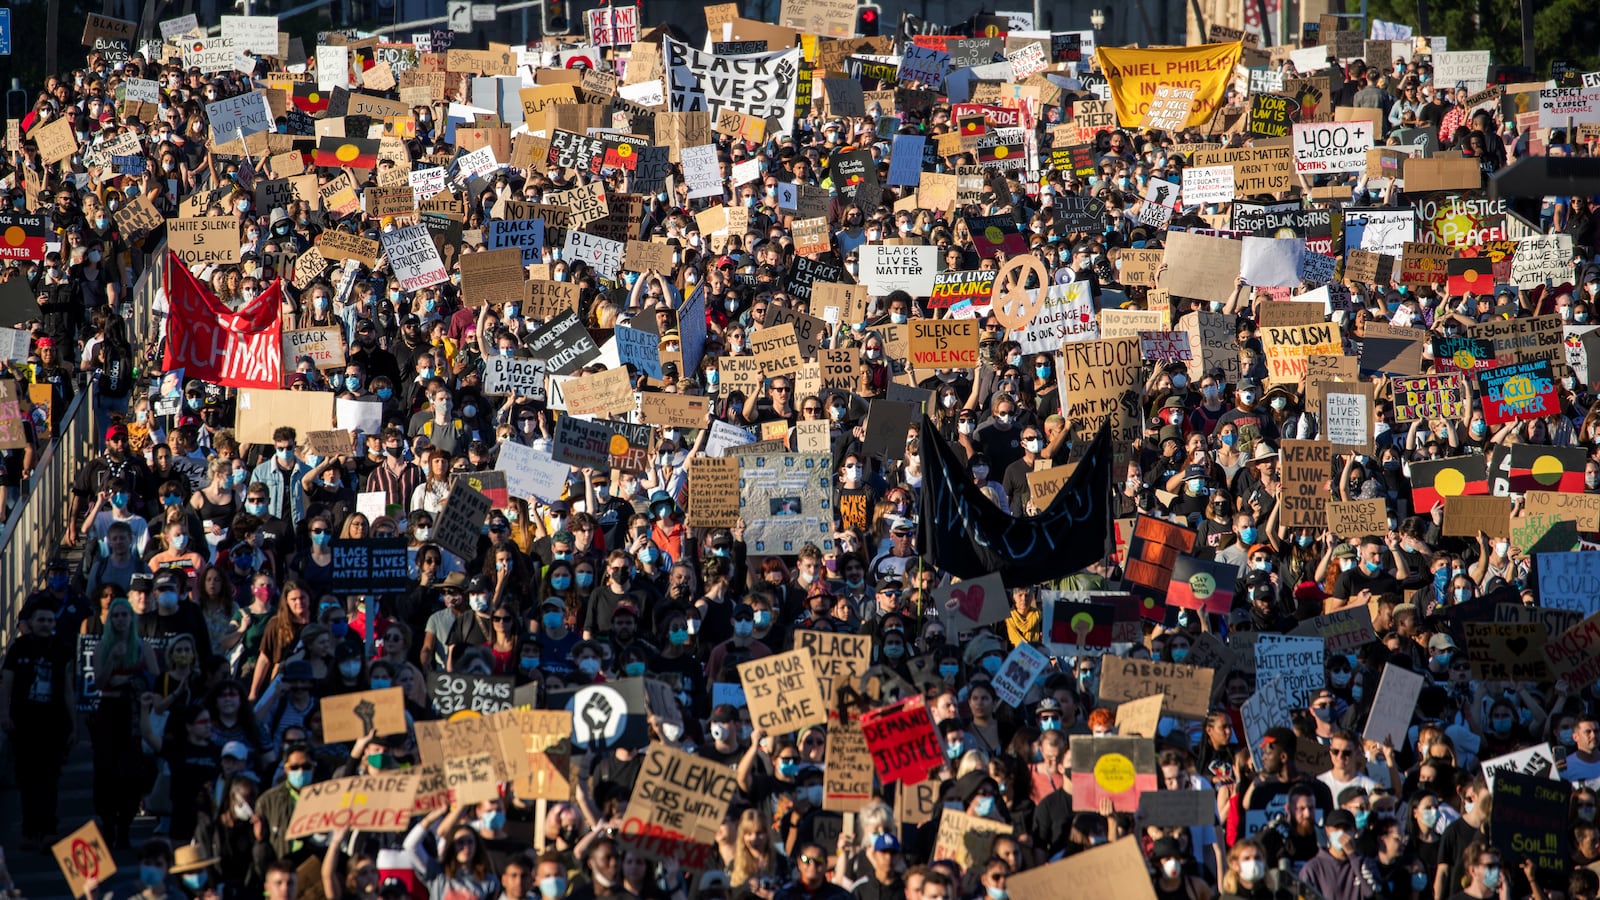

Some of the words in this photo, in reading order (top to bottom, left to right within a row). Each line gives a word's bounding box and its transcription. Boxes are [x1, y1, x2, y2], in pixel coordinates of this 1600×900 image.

[592, 11, 608, 26] WE
[95, 40, 128, 50] BLACK
[204, 38, 234, 49] JUSTICE
[958, 39, 990, 48] ENOUGH
[205, 52, 234, 62] PEACE
[670, 42, 771, 75] BLACK
[906, 48, 950, 62] BLAK
[862, 65, 898, 82] JUSTICE
[901, 66, 940, 84] MATTER
[670, 72, 767, 101] LIVES
[1540, 88, 1582, 98] RESPECT
[1158, 89, 1169, 98] NO
[1171, 89, 1194, 100] JUSTICE
[1466, 89, 1498, 106] MURDER
[1556, 94, 1599, 102] EXISTENCE
[210, 93, 263, 116] SILENCE
[1081, 102, 1106, 112] SAY
[1152, 100, 1164, 108] NO
[1166, 101, 1188, 110] PEACE
[1260, 96, 1286, 110] YOUR
[1551, 105, 1592, 114] RESISTANCE
[984, 109, 1018, 126] PRIDE
[1075, 114, 1112, 126] THEIR
[1253, 110, 1271, 120] LAW
[1274, 112, 1285, 121] IS
[214, 111, 267, 134] VIOLENCE
[1150, 118, 1179, 129] POLICE
[1252, 122, 1287, 136] KILLING
[1206, 152, 1222, 164] ALL
[1225, 151, 1250, 162] LIVES
[1253, 148, 1289, 160] MATTER
[1299, 144, 1369, 158] INDIGENOUS
[460, 151, 486, 167] BLACK
[1298, 160, 1326, 171] DEATHS
[1272, 163, 1288, 173] YOU
[266, 182, 298, 195] BLACK
[1235, 179, 1266, 190] WITH
[1269, 176, 1288, 188] US?
[506, 202, 526, 219] NO
[529, 205, 570, 222] JUSTICE
[1412, 200, 1436, 221] NO
[1446, 196, 1506, 218] JUSTICE
[20, 218, 40, 226] LIVES
[170, 221, 198, 232] WHITE
[200, 220, 236, 230] SILENCE
[496, 220, 534, 234] BLACK
[792, 218, 822, 228] WHITE
[1240, 218, 1264, 230] STOP
[1266, 213, 1294, 228] BLAK
[1297, 213, 1330, 227] DEATHS
[382, 227, 428, 246] DISMANTLE
[496, 234, 535, 246] LIVES
[804, 235, 818, 244] IS
[390, 240, 431, 258] POWER
[878, 246, 917, 255] BLACK
[1531, 240, 1560, 250] HEAR
[394, 248, 437, 270] STRUCTURES
[878, 256, 919, 266] LIVES
[1122, 254, 1136, 262] MY
[1139, 252, 1160, 262] SKIN
[410, 265, 421, 275] OF
[876, 266, 922, 275] MATTER
[1127, 272, 1144, 281] NOT
[401, 269, 446, 290] OPPRESSION
[936, 274, 960, 284] BLACK
[964, 271, 994, 281] LIVES
[1513, 271, 1543, 285] WITH
[532, 285, 570, 299] BLACK
[932, 282, 990, 297] FUCKING
[531, 296, 572, 308] LIVES
[1028, 310, 1079, 326] VIOLENCE
[773, 311, 811, 340] ACAB
[915, 324, 971, 337] SILENCE
[1027, 333, 1036, 341] IS
[1039, 329, 1054, 339] OUR
[1058, 322, 1095, 338] SILENCE
[1468, 326, 1482, 338] IF
[1526, 318, 1561, 332] TIRED
[292, 332, 327, 346] BLACK
[1270, 326, 1331, 345] RACISM
[1445, 337, 1477, 347] WHITE
[1538, 332, 1563, 345] BOUT
[753, 335, 799, 353] JUSTICE
[936, 337, 947, 349] IS
[827, 351, 850, 363] 432
[915, 350, 976, 363] VIOLENCE
[1065, 340, 1140, 370] FREEDOM
[1146, 350, 1191, 360] SENTENCE
[1268, 348, 1278, 358] IS
[1284, 346, 1302, 356] THE
[1440, 347, 1487, 357] SILENCE
[495, 361, 544, 374] BLACK
[721, 359, 736, 371] WE
[760, 356, 798, 372] PEACE
[1308, 356, 1338, 369] 432
[825, 365, 852, 374] TOO
[1481, 372, 1494, 381] ALL
[1495, 366, 1517, 377] LIVES
[500, 375, 535, 384] LIVES
[734, 373, 748, 381] DO
[825, 375, 859, 388] MANY
[1069, 373, 1080, 391] IS
[1085, 374, 1099, 389] A
[1102, 366, 1142, 388] MUST
[495, 384, 544, 395] MATTER
[1394, 378, 1426, 393] STOP
[1489, 383, 1523, 401] BLACK
[1524, 378, 1553, 396] LIVES
[1329, 398, 1359, 406] #BLAK
[1408, 390, 1455, 406] DEATHS
[659, 407, 684, 416] LIVES
[1070, 399, 1096, 416] AIN'T
[1101, 397, 1118, 412] NO
[1331, 408, 1360, 416] LIVES
[1396, 405, 1414, 419] IN
[1415, 402, 1463, 419] CUSTODY
[1499, 396, 1546, 417] MATTER
[800, 424, 827, 434] SILENCE
[1329, 418, 1361, 427] MATTER
[562, 421, 587, 439] Why
[1299, 485, 1317, 495] ON
[1334, 504, 1376, 514] THINGS
[1341, 513, 1373, 523] MUST
[1336, 522, 1385, 533] CHANGE
[334, 547, 368, 556] BLACK
[334, 556, 368, 568] LIVES
[372, 556, 406, 568] LIVES
[333, 570, 368, 578] MATTER
[372, 570, 406, 578] MATTER
[801, 633, 864, 657] BLACK
[1255, 654, 1284, 669] WHITE
[1286, 651, 1323, 667] PEOPLE
[744, 656, 804, 683] COLOUR
[1123, 663, 1194, 678] ABOLISH
[434, 677, 467, 694] 30
[472, 679, 510, 699] YEARS
[752, 684, 771, 697] IS
[778, 675, 803, 690] NOT
[776, 693, 787, 706] A
[759, 700, 814, 728] CRIME
[863, 708, 928, 743] DEMAND
[647, 751, 737, 801] SILENCE
[305, 782, 341, 798] NO
[351, 777, 407, 793] PRIDE
[640, 782, 679, 809] SIDES
[684, 794, 718, 818] WITH
[292, 809, 408, 835] GENOCIDE
[656, 807, 683, 828] THE
